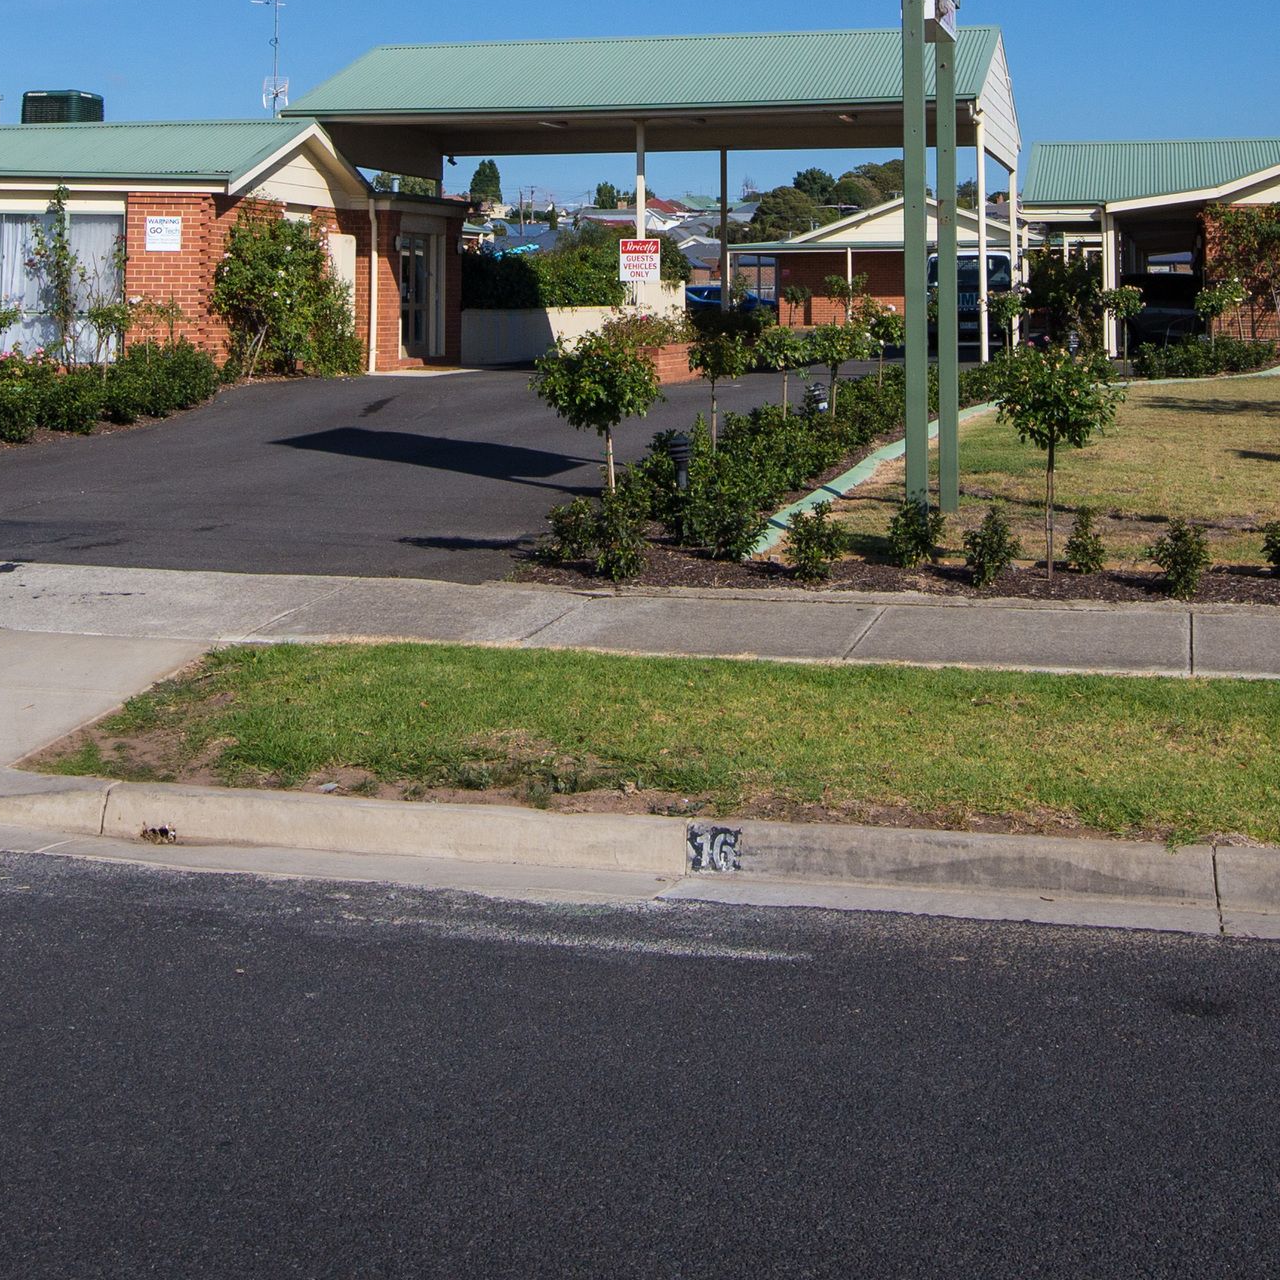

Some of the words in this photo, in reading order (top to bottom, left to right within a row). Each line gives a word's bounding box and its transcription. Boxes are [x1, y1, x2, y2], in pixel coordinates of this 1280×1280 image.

[150, 226, 163, 234] GO
[622, 241, 657, 254] Strictly
[695, 832, 736, 871] 16
